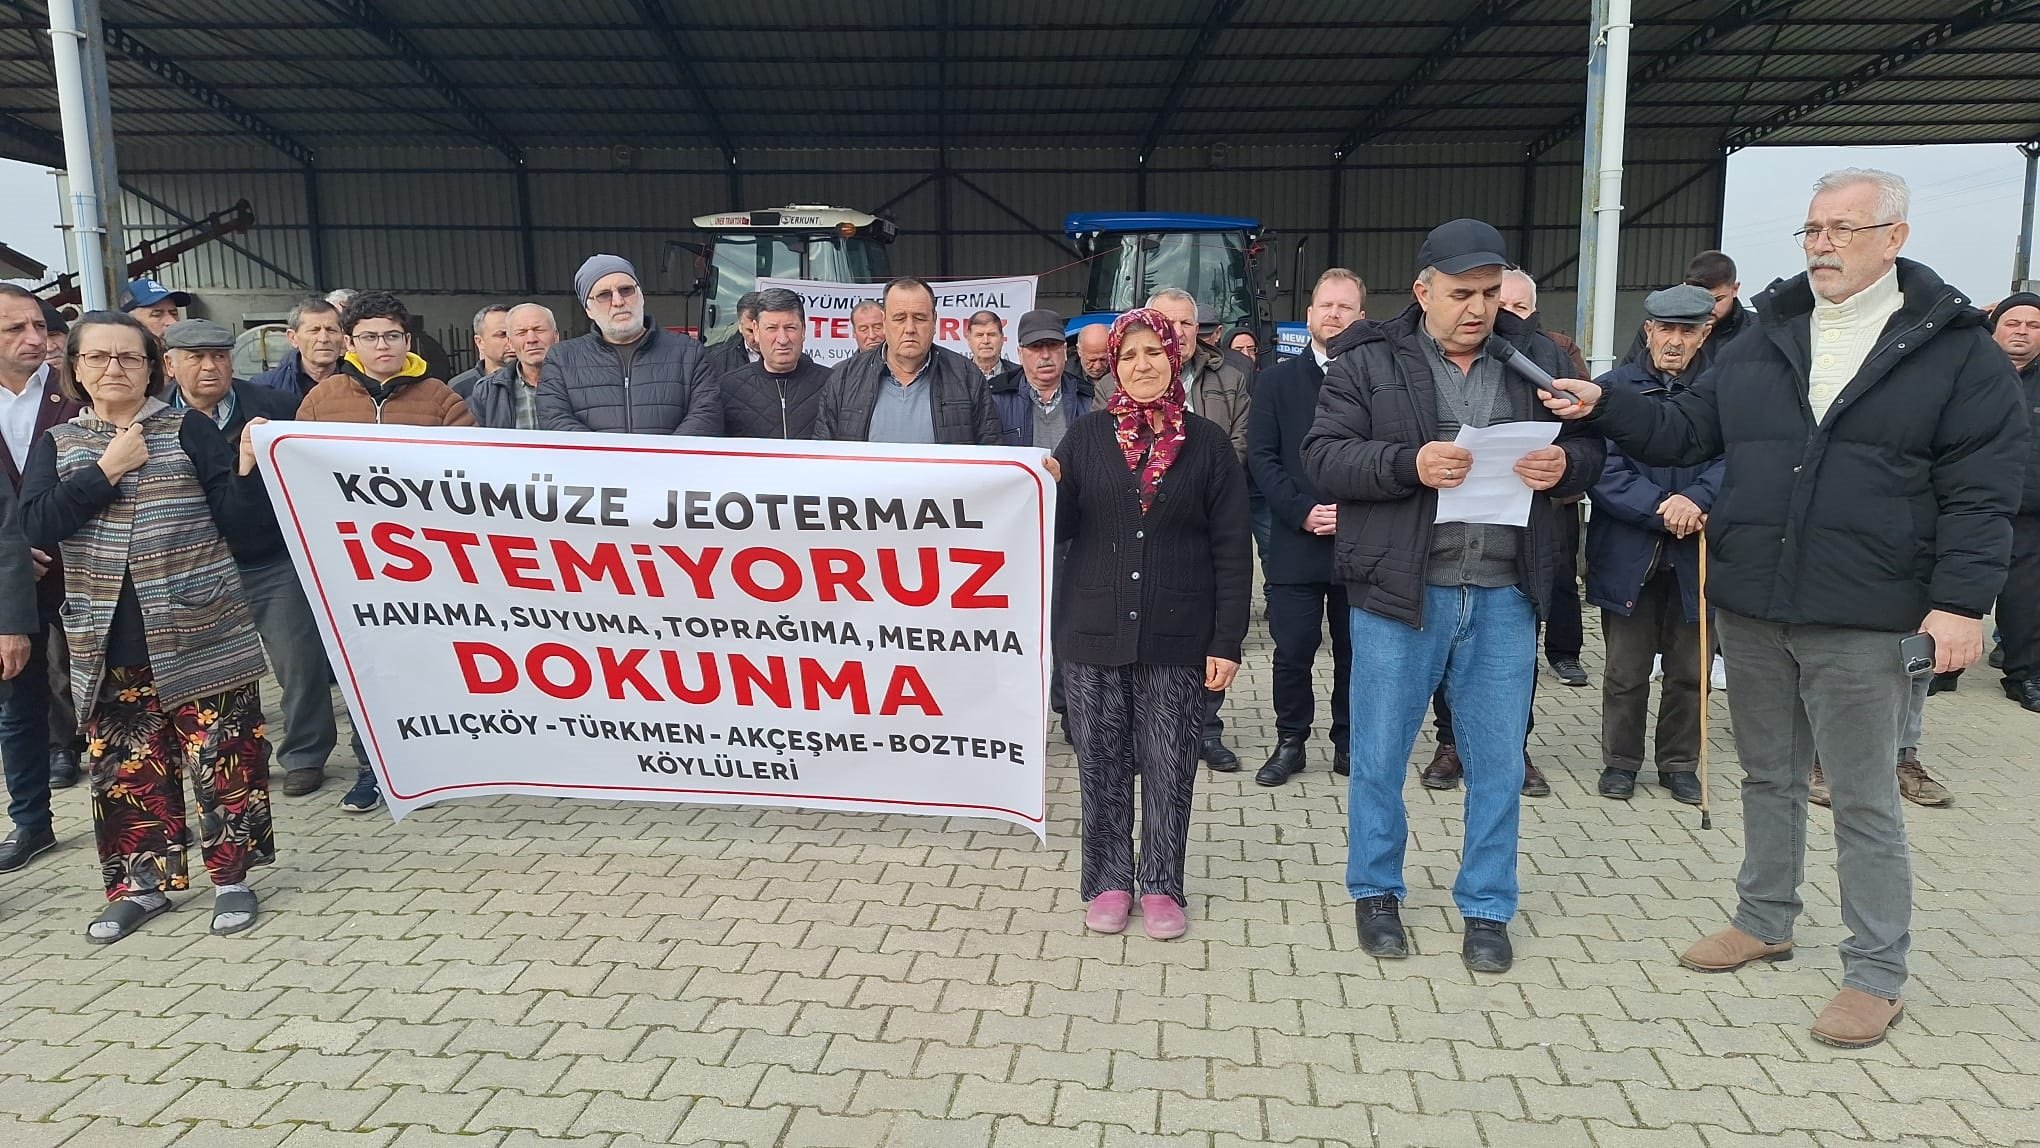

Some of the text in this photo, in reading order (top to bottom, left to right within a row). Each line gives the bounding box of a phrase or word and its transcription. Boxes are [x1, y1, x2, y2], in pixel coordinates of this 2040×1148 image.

[1282, 333, 1305, 344] NEW
[333, 467, 984, 530] KÖYÜMÜZE JEOTERMAL
[453, 642, 943, 717] DOKUNMA
[638, 750, 799, 781] KÖYLÜLERİ
